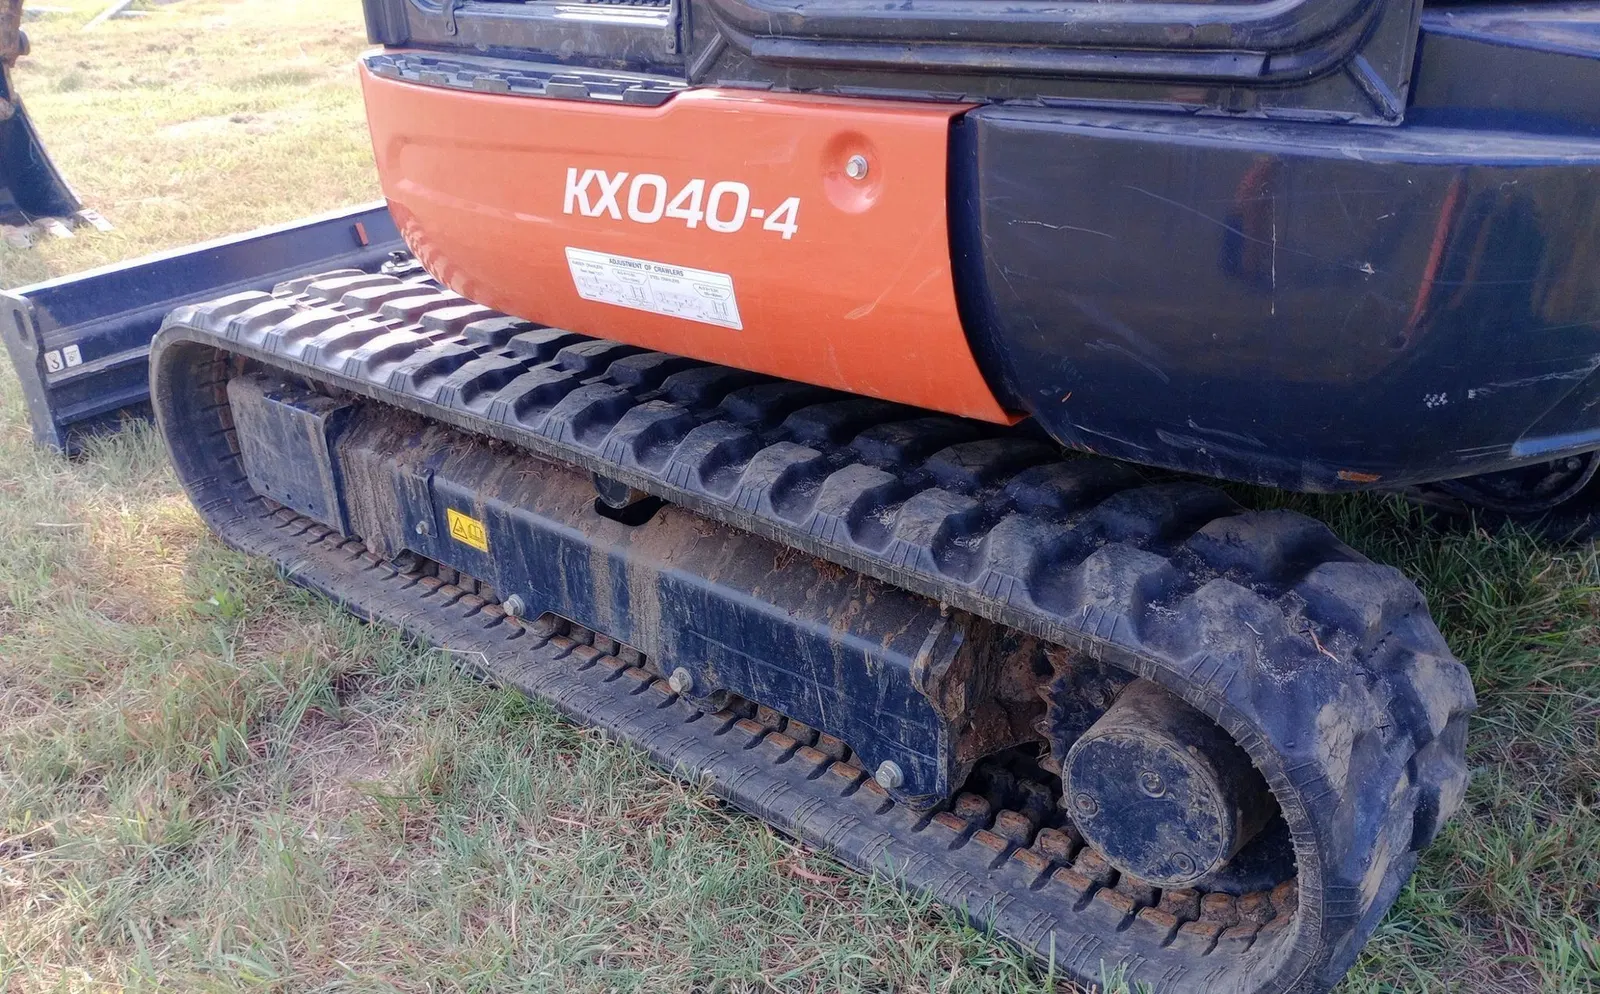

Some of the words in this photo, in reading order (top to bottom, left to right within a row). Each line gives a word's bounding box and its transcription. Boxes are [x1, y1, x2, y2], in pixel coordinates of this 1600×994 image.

[563, 167, 800, 240] KX040-4
[609, 258, 642, 269] ADJUSTMENT
[653, 266, 684, 277] CRAWLERS
